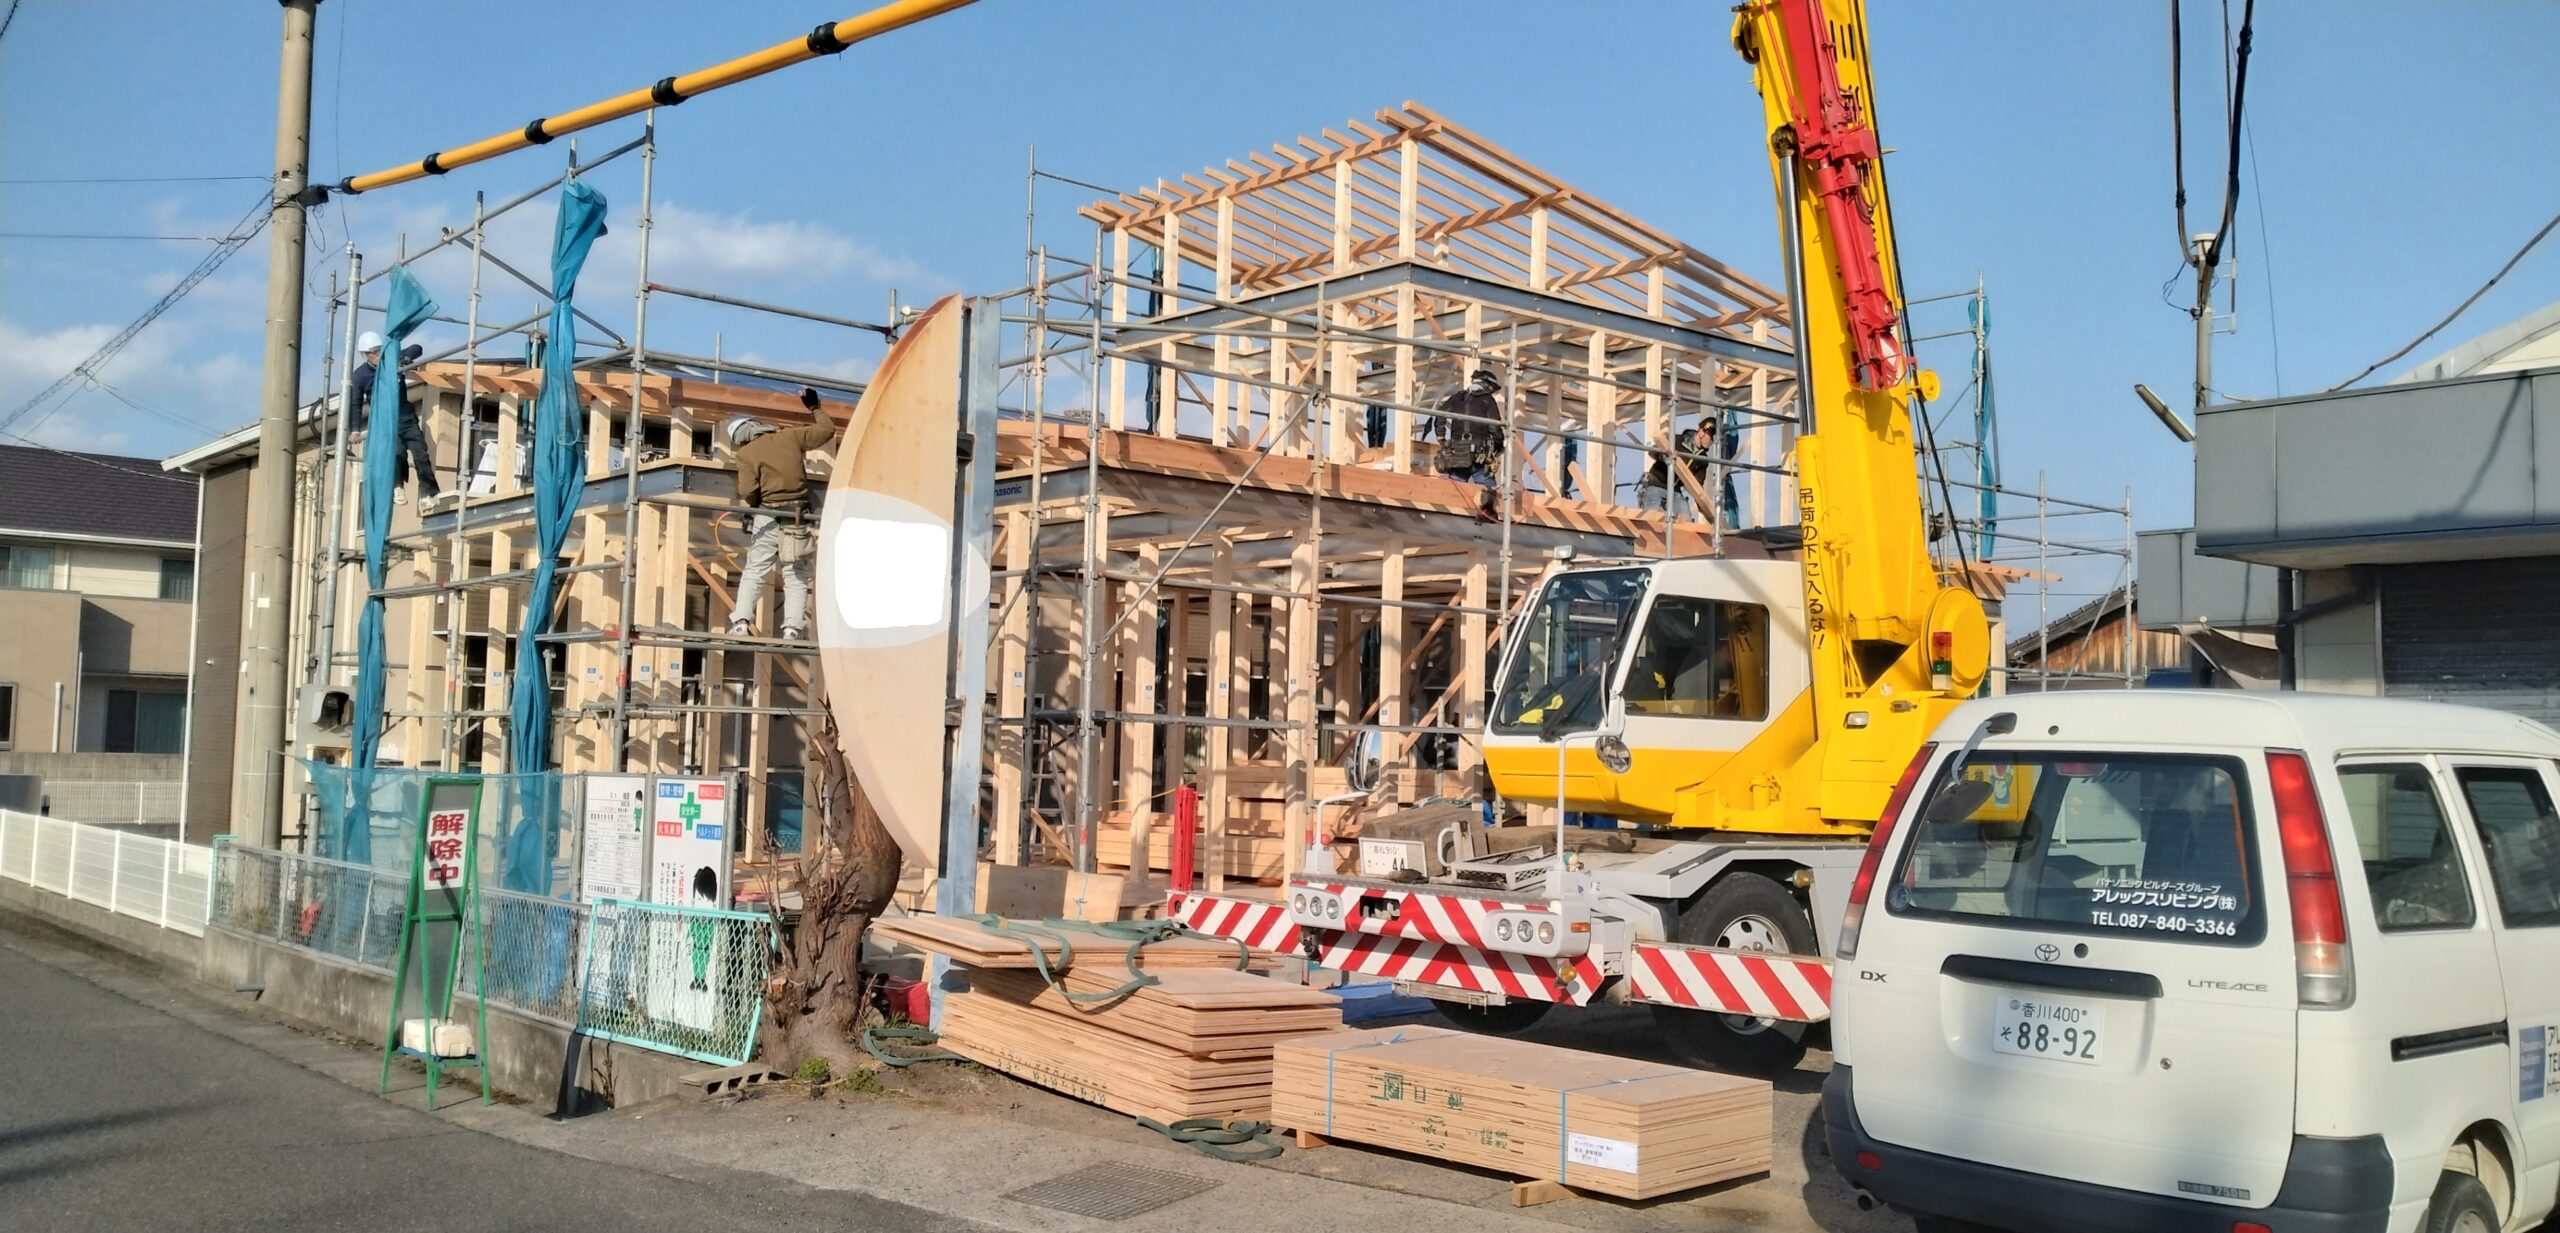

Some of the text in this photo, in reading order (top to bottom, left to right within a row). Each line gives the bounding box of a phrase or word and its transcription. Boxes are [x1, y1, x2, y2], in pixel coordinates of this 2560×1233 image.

[429, 813, 465, 886] 解除中
[2096, 878, 2221, 893] パナソニックビルダーズグループ
[2092, 911, 2237, 937] TEL.087-840-3366
[1861, 970, 1888, 984] DX
[2188, 979, 2269, 993] LITEACE
[2021, 1002, 2080, 1023] 香川400
[2000, 1021, 2097, 1060] そ 88-92
